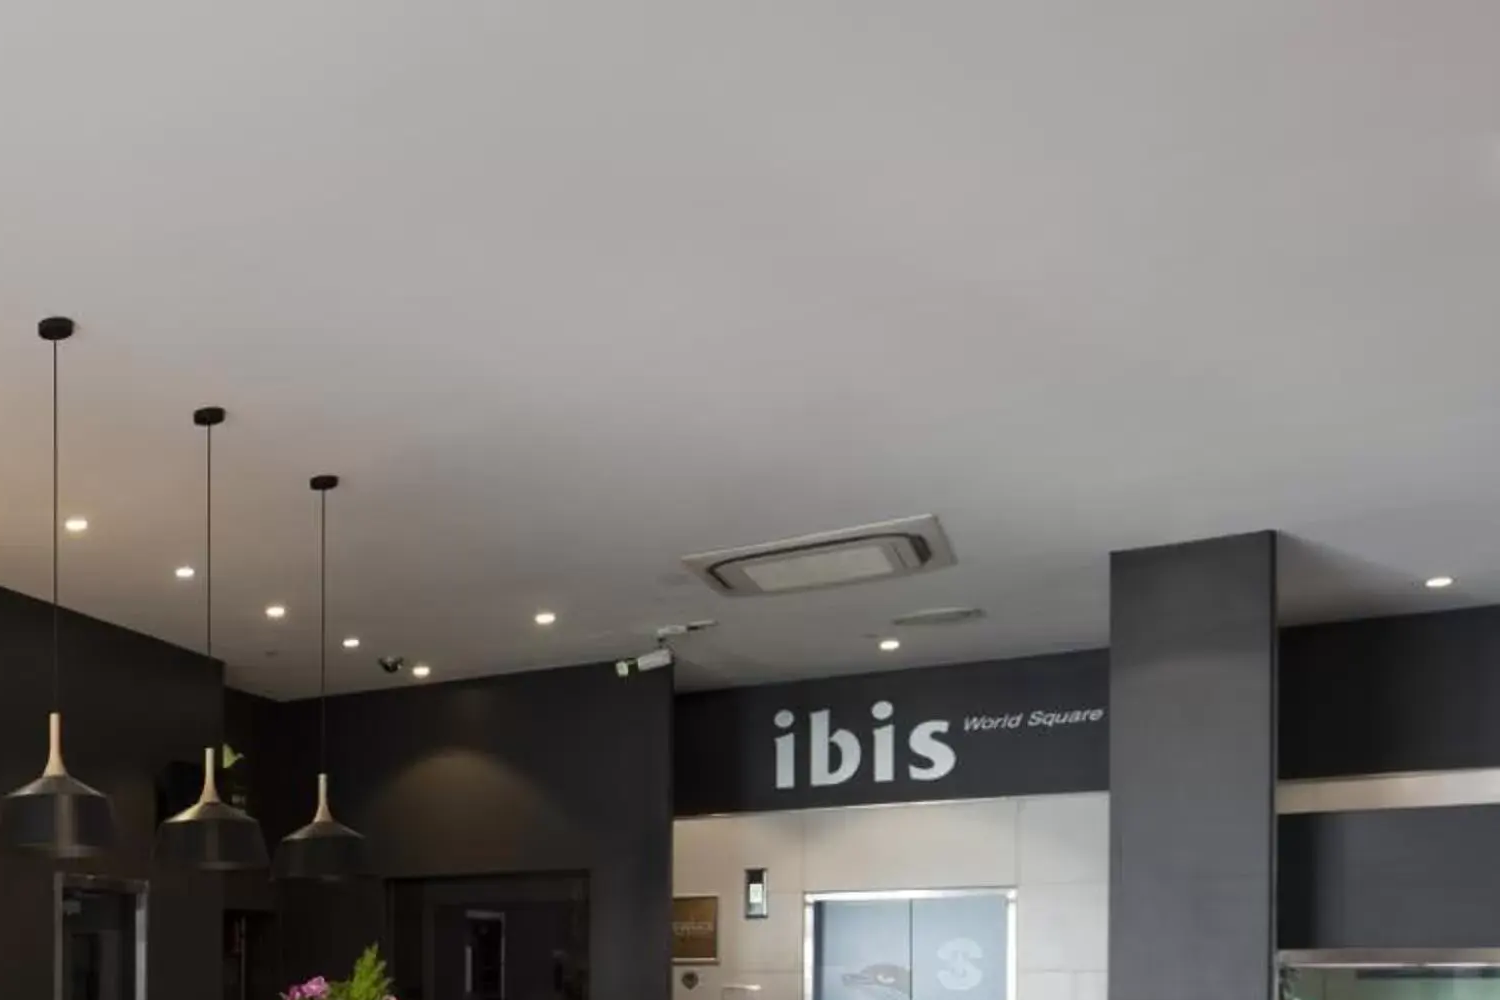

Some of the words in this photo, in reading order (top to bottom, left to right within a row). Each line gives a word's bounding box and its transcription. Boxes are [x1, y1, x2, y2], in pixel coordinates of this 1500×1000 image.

[774, 701, 956, 789] ibis
[963, 712, 1024, 732] World
[1027, 708, 1105, 727] Square
